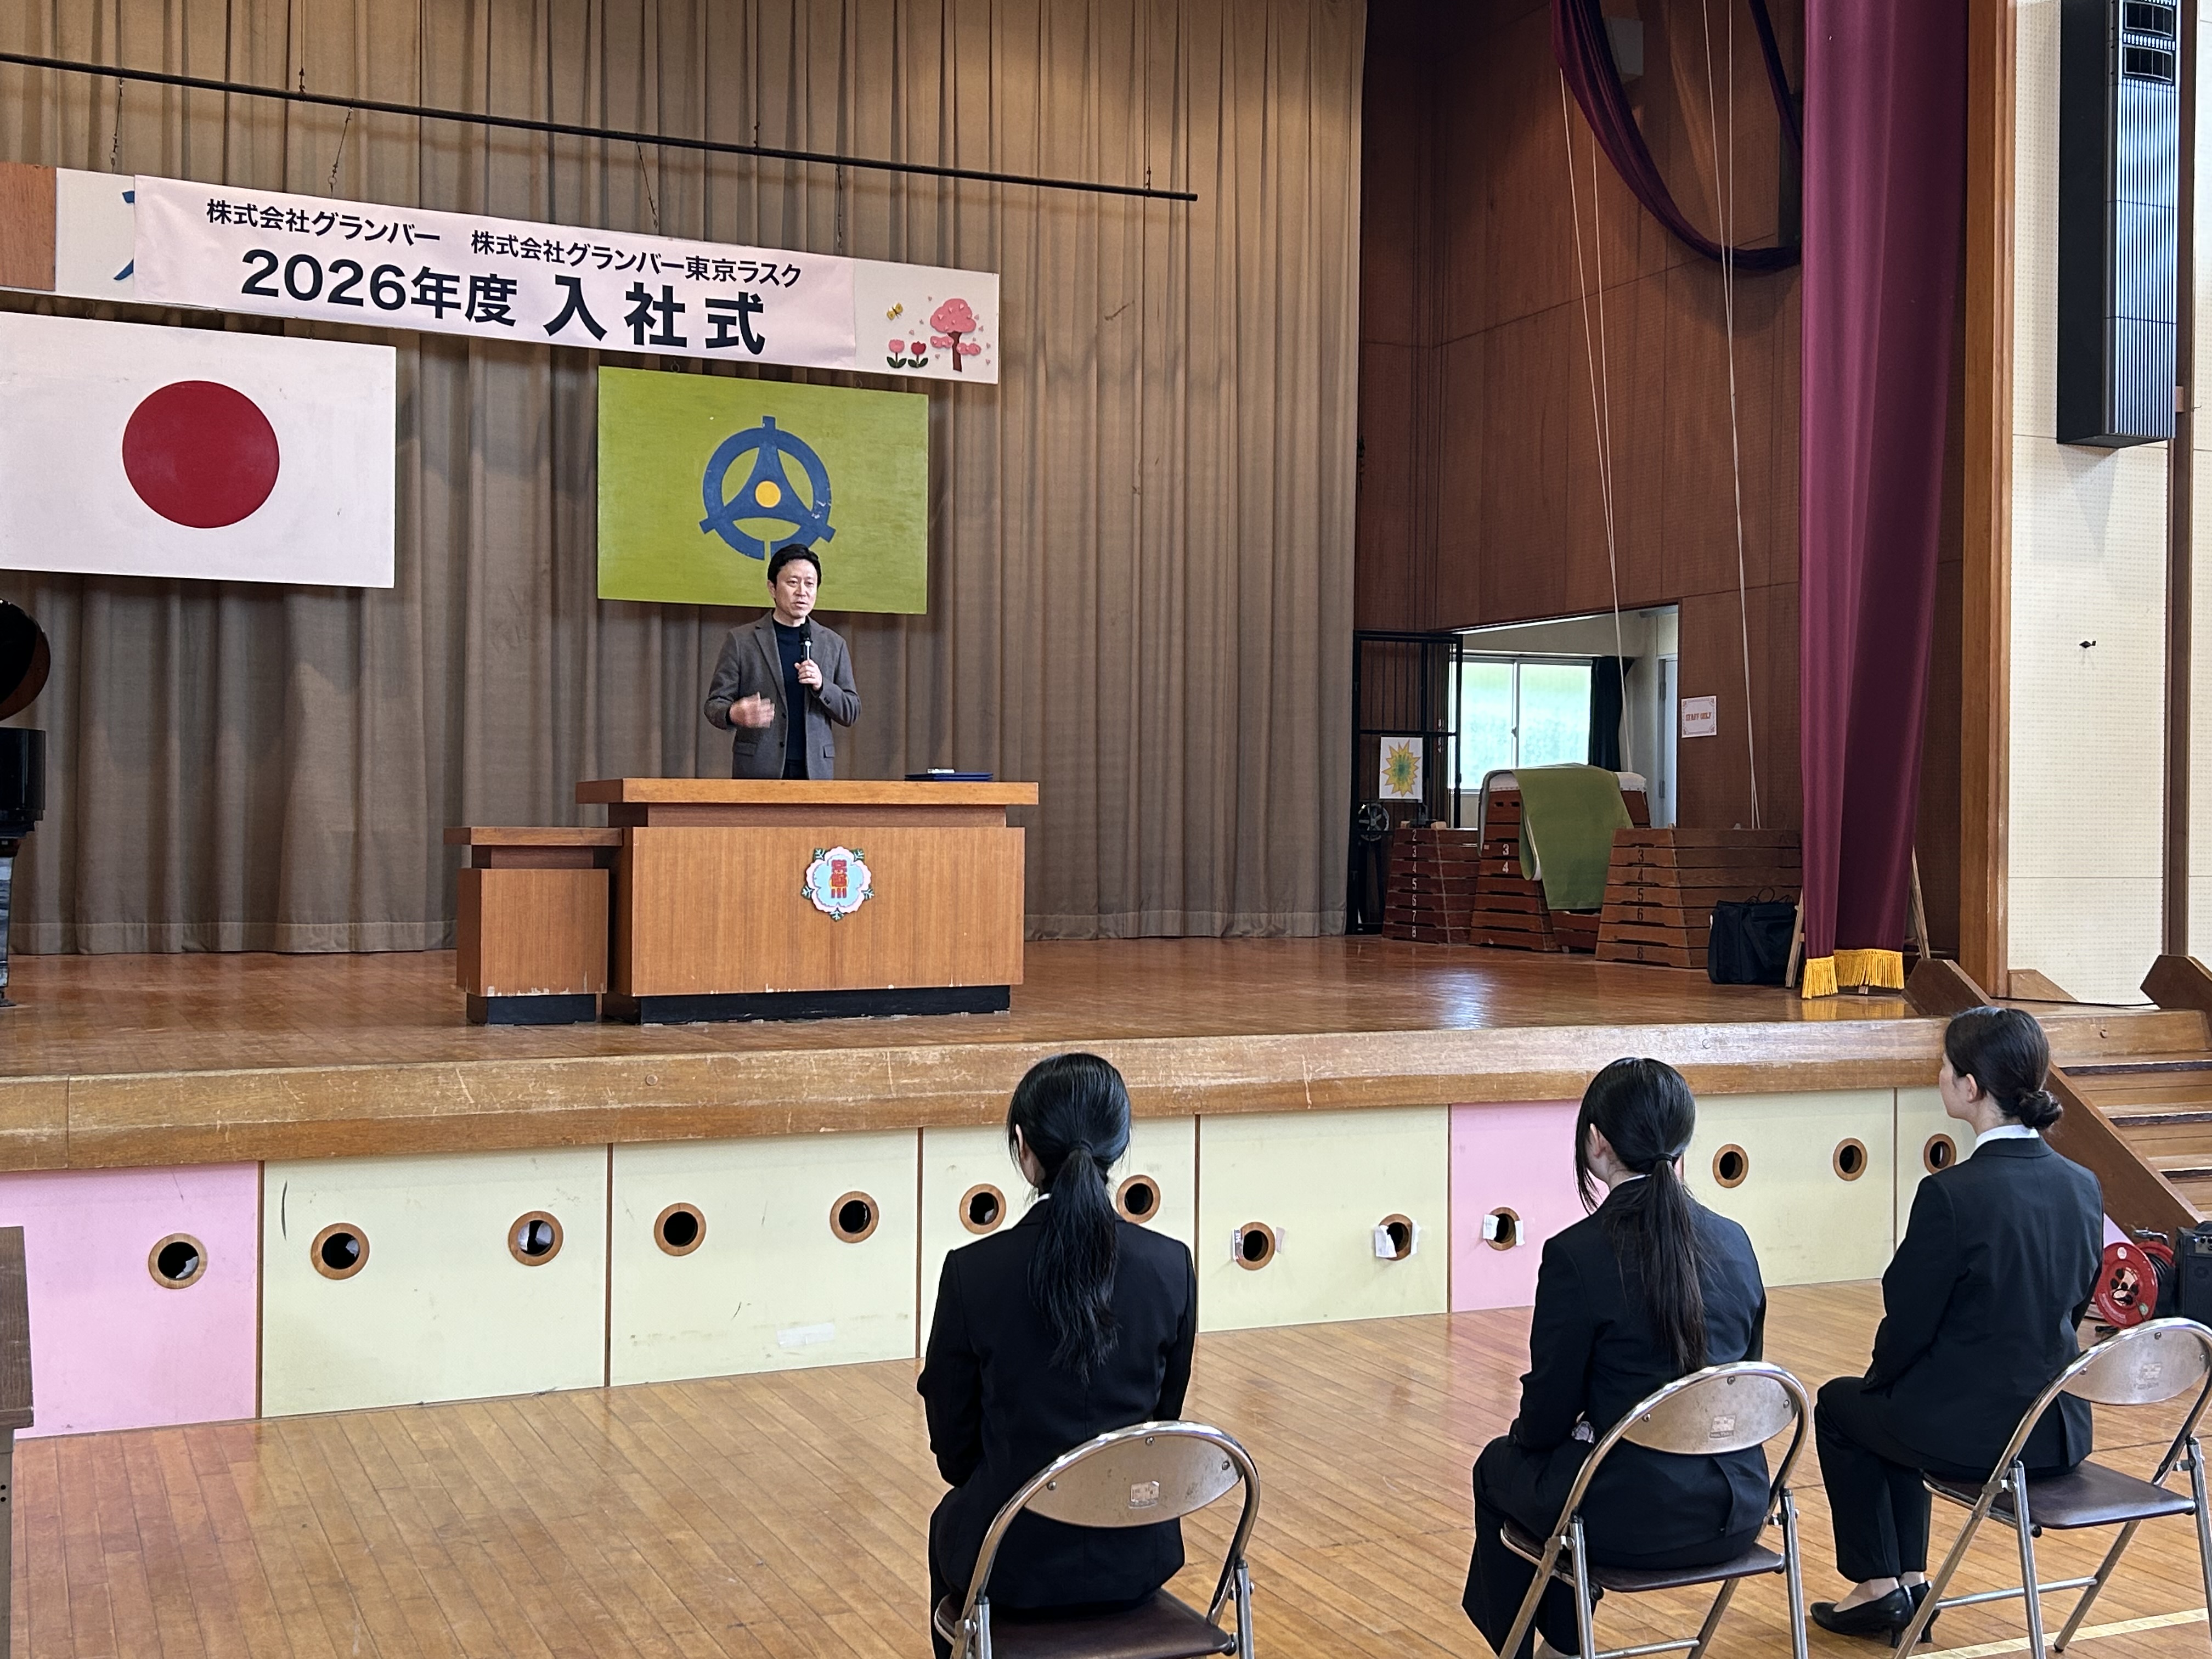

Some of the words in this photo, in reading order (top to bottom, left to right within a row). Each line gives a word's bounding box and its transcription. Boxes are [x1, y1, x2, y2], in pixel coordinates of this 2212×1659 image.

[206, 198, 441, 247] 株式会社グランバー
[471, 230, 802, 289] 株式会社グランバー東京ラスク
[241, 249, 517, 328] 2026年度
[543, 274, 766, 356] 入社式
[1412, 845, 1417, 857] 3
[1503, 844, 1509, 855] 3
[1638, 849, 1644, 862] 3
[1412, 862, 1417, 873] 4
[1502, 861, 1509, 873] 4
[1638, 868, 1644, 882] 4
[1412, 878, 1417, 890] 5
[1412, 894, 1417, 906] 6
[1637, 888, 1644, 901] 5
[1412, 910, 1417, 922] 7
[1637, 908, 1644, 921] 6
[1412, 926, 1416, 938] 8
